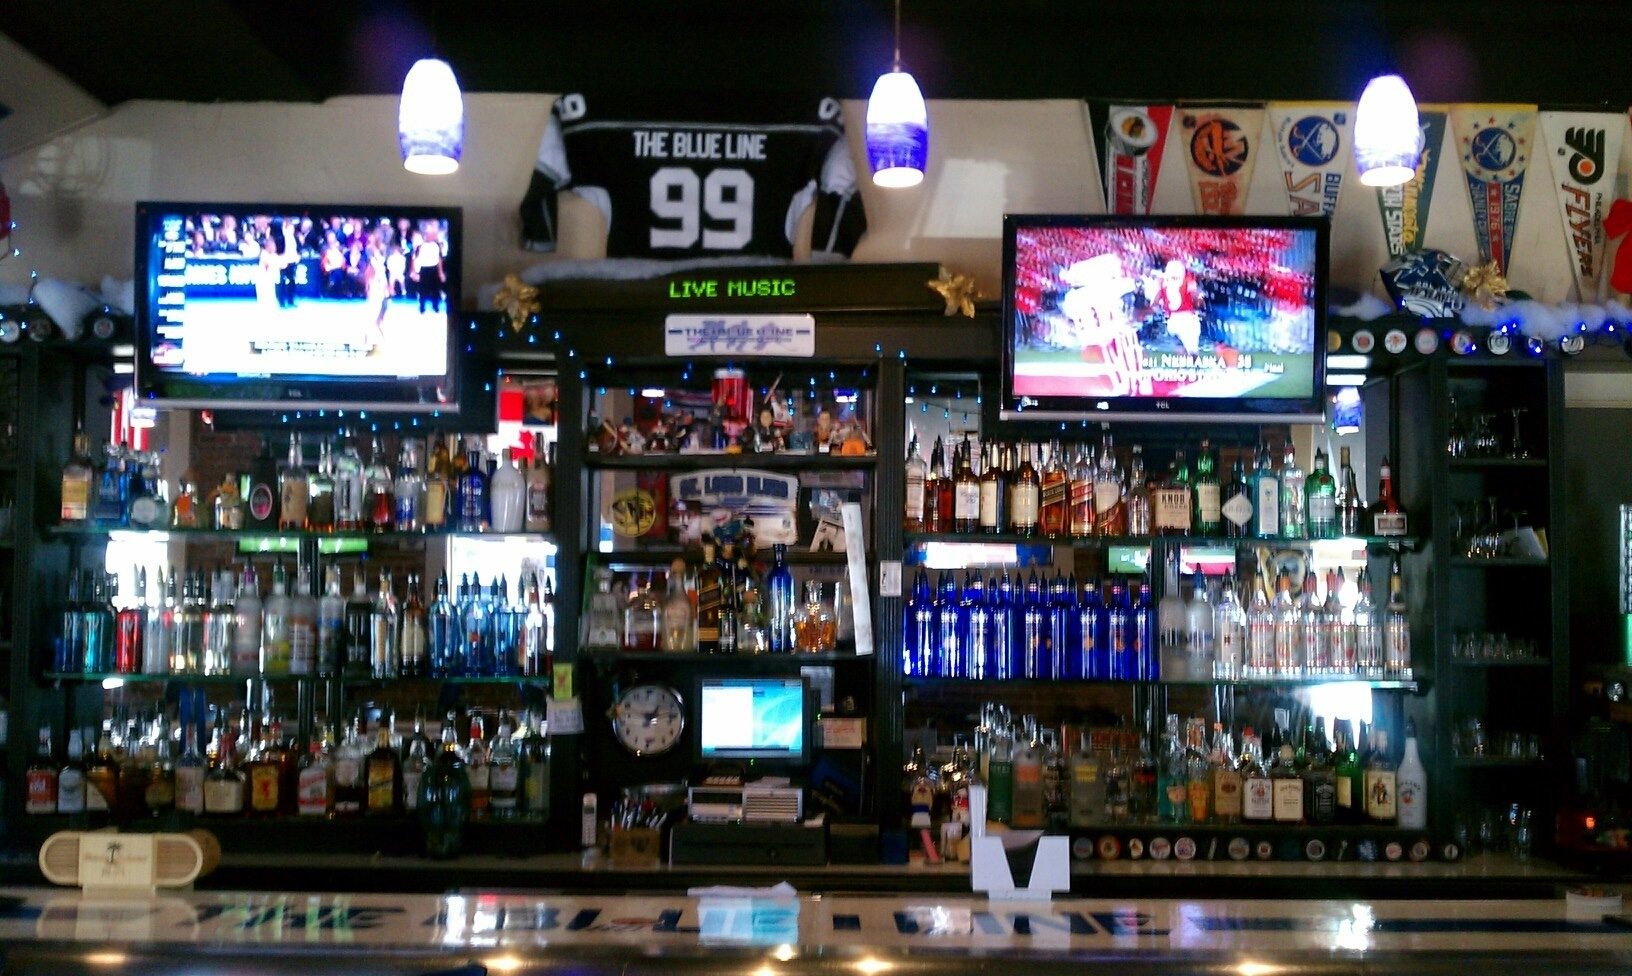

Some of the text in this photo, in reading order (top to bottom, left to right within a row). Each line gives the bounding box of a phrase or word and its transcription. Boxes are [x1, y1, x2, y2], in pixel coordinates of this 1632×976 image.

[634, 131, 767, 160] THE BLUE LINE
[650, 167, 754, 250] 99
[1561, 183, 1594, 279] FLYERS
[669, 279, 796, 298] LIVE MUSIC
